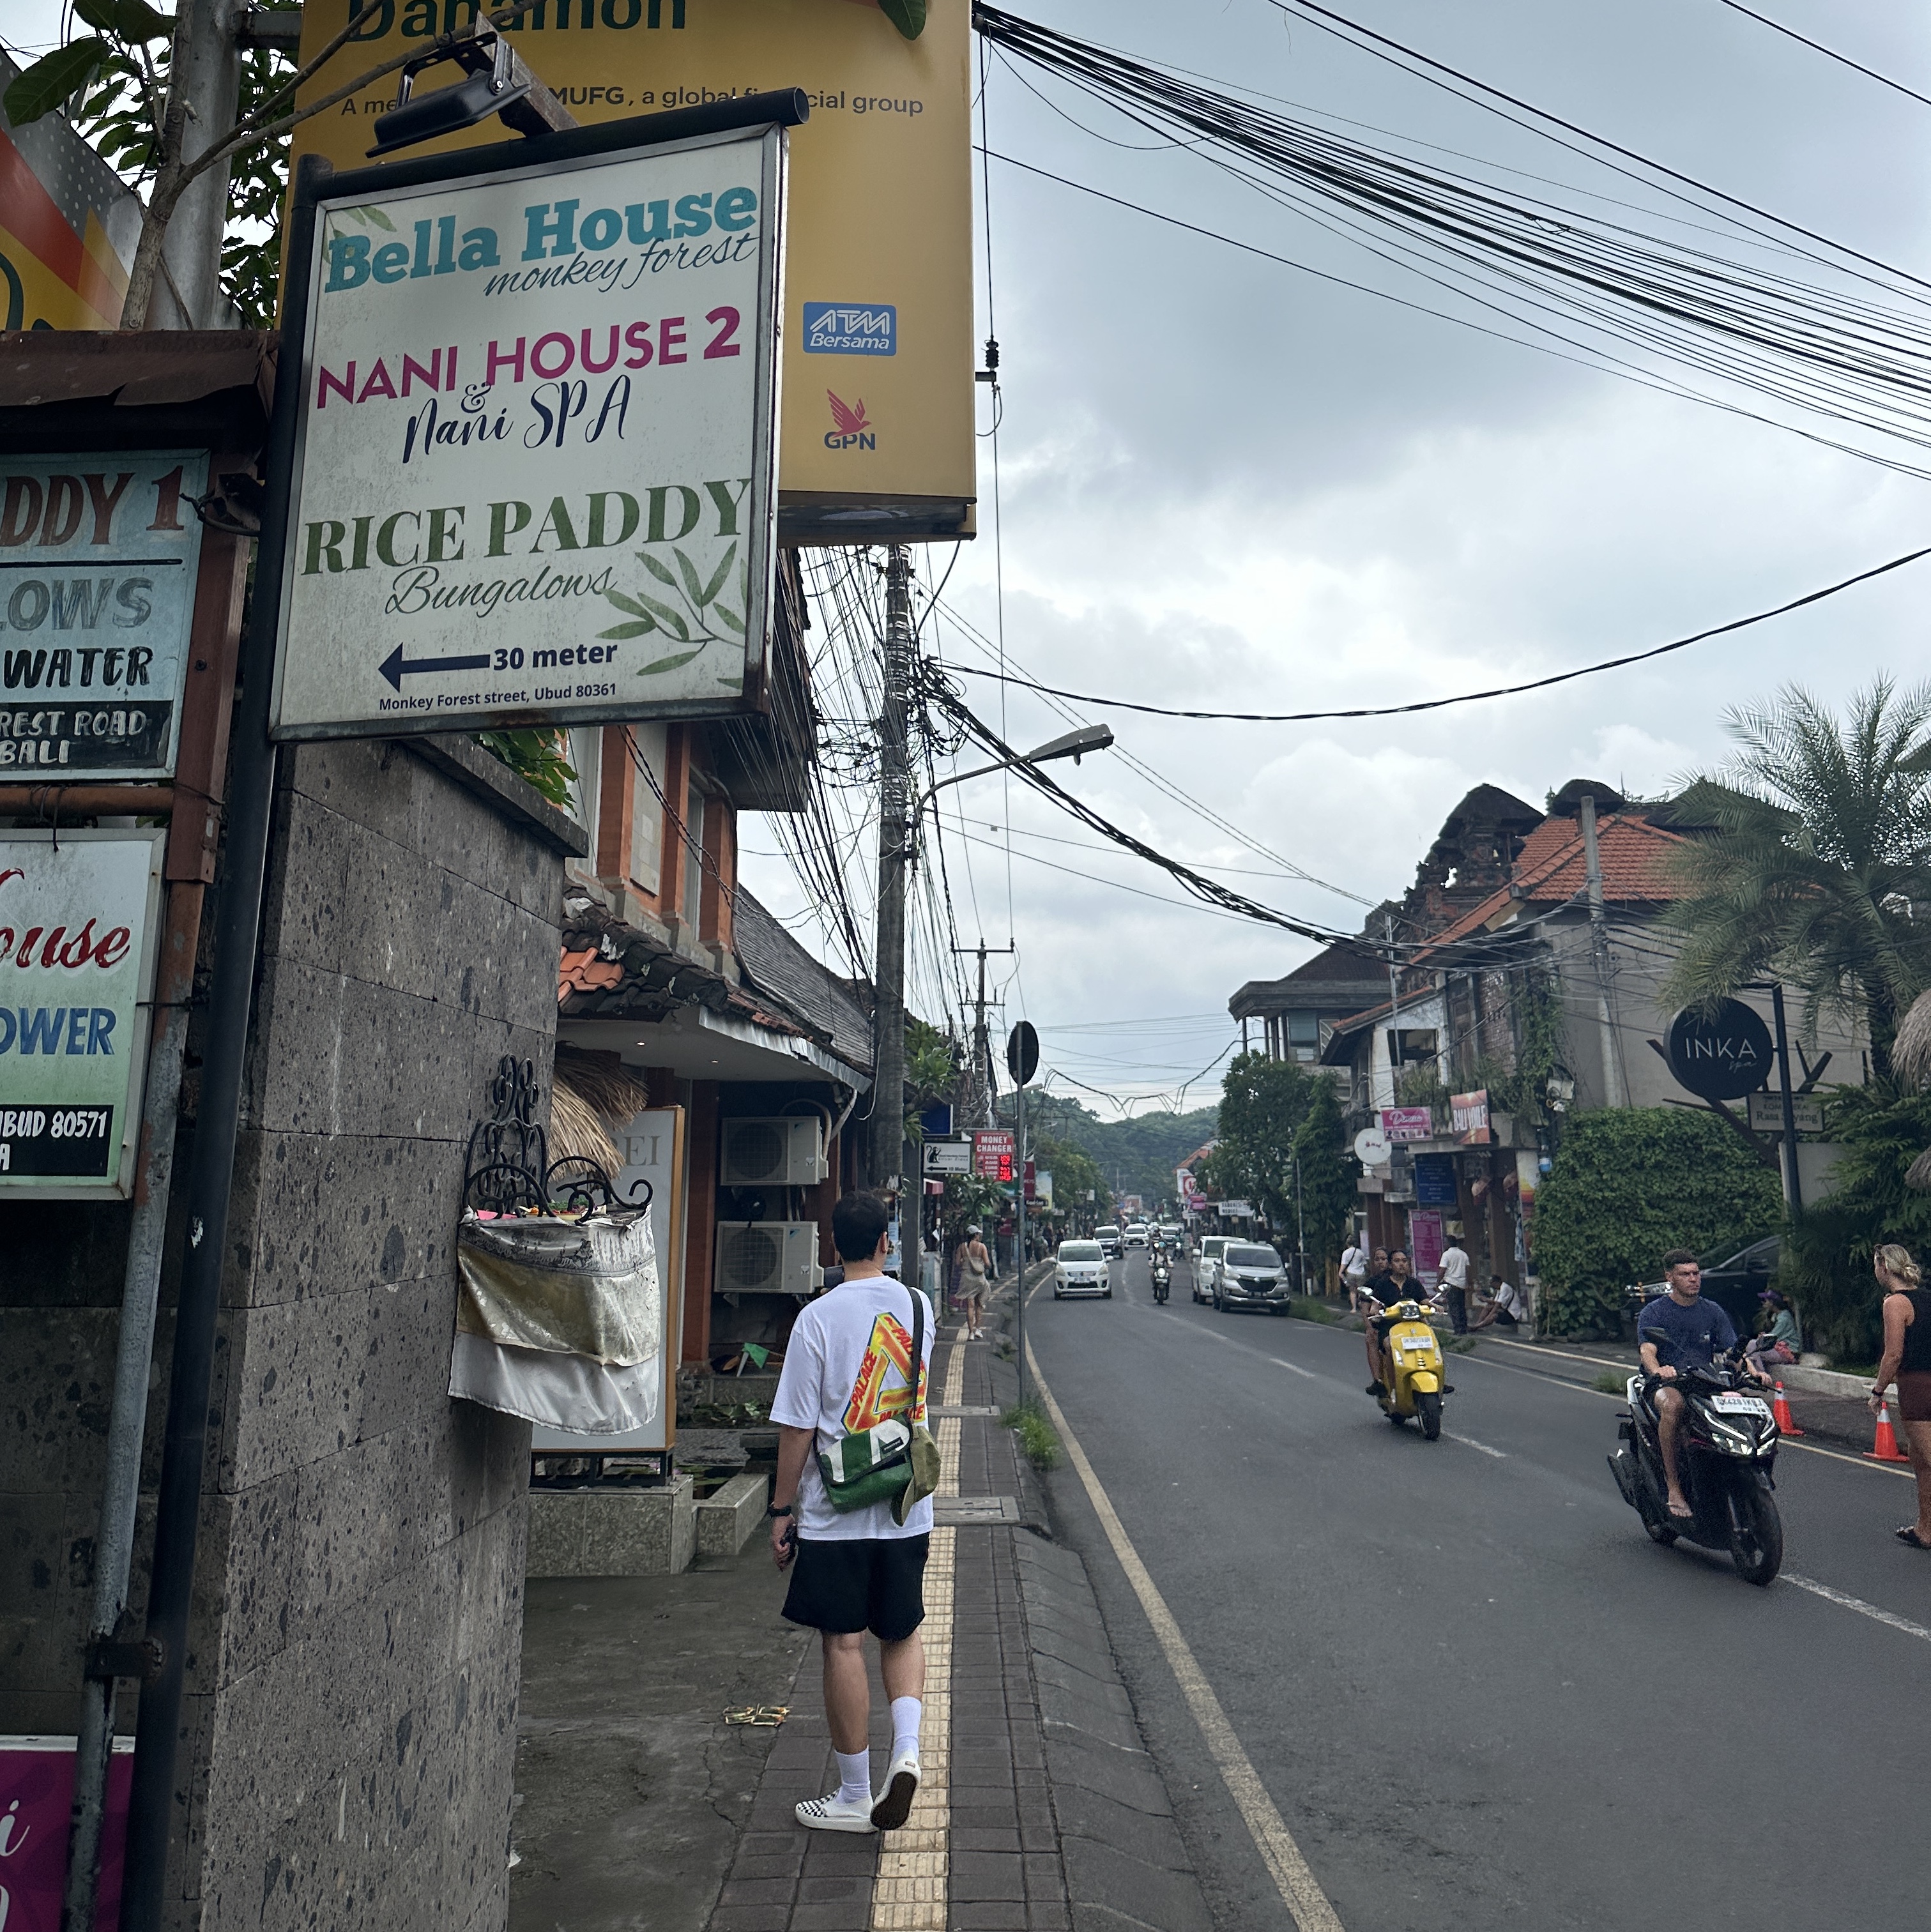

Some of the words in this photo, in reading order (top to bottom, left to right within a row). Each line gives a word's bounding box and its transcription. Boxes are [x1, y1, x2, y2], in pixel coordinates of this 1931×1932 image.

[642, 91, 655, 105] a
[852, 95, 924, 117] group
[325, 216, 500, 293] Bella
[521, 186, 758, 261] House
[483, 251, 629, 296] monkey
[622, 232, 761, 290] forest
[809, 309, 890, 335] ATM
[809, 333, 890, 349] Bersama
[317, 346, 459, 409] NANI
[485, 316, 688, 386] HOUSE
[703, 305, 741, 360] 2
[461, 381, 492, 413] &
[402, 398, 513, 464] Nani
[523, 374, 630, 449] SPA
[824, 431, 876, 450] GPN
[146, 466, 185, 531] 1
[300, 505, 467, 576] RICE
[484, 478, 752, 558] PADDY
[0, 577, 153, 631] OWS
[384, 566, 618, 618] Bungalows
[3, 646, 153, 689] WATER
[493, 648, 524, 671] 30
[532, 644, 618, 669] meter
[379, 696, 434, 711] Monkey
[437, 692, 480, 707] Forest
[484, 689, 530, 705] street,
[535, 685, 572, 701] Ubud
[576, 683, 616, 697] 80361
[74, 710, 147, 736] ROAD
[0, 740, 70, 764] BALI
[1686, 1038, 1757, 1059] INKA
[0, 1110, 46, 1137] BUD
[51, 1110, 107, 1139] 80571
[977, 1144, 1012, 1152] CHANGER
[851, 1346, 878, 1406] PALACE
